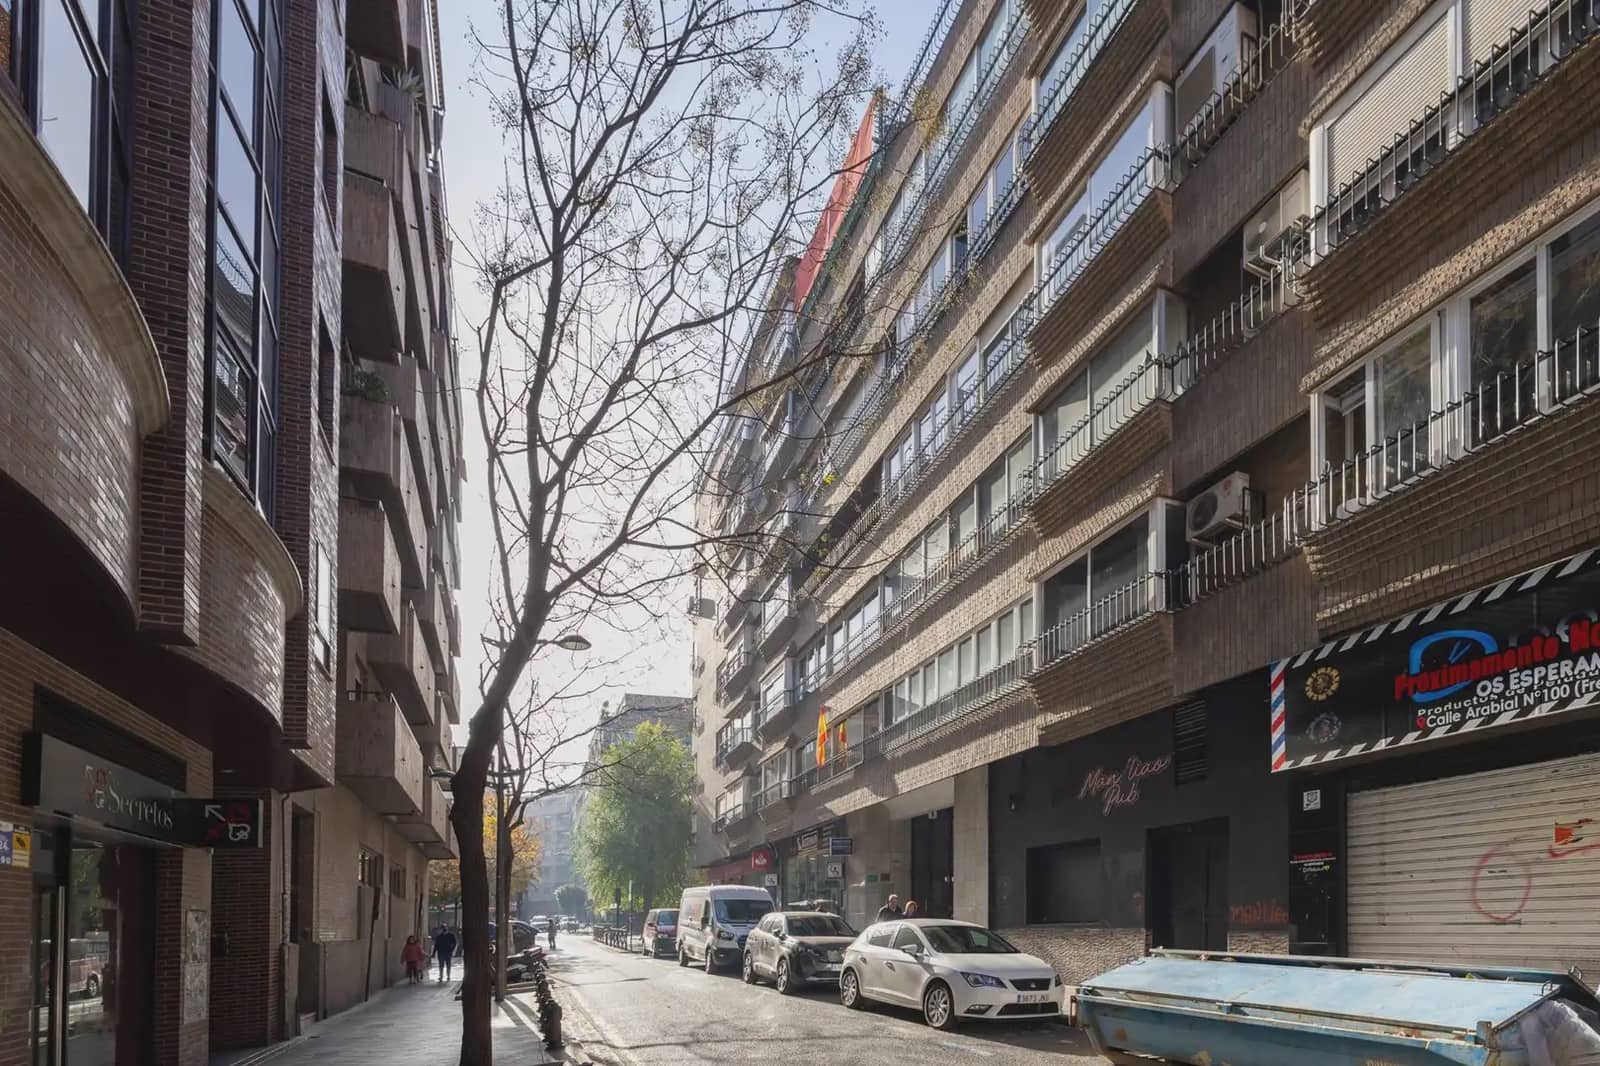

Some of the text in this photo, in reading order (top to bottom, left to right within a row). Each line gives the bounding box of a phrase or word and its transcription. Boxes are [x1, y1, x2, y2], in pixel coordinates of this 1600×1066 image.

[1476, 675, 1504, 697] OS
[1426, 711, 1462, 728] Calle
[1466, 696, 1518, 720] Arabial
[107, 784, 174, 830] Secretos
[1103, 782, 1139, 816] Pub
